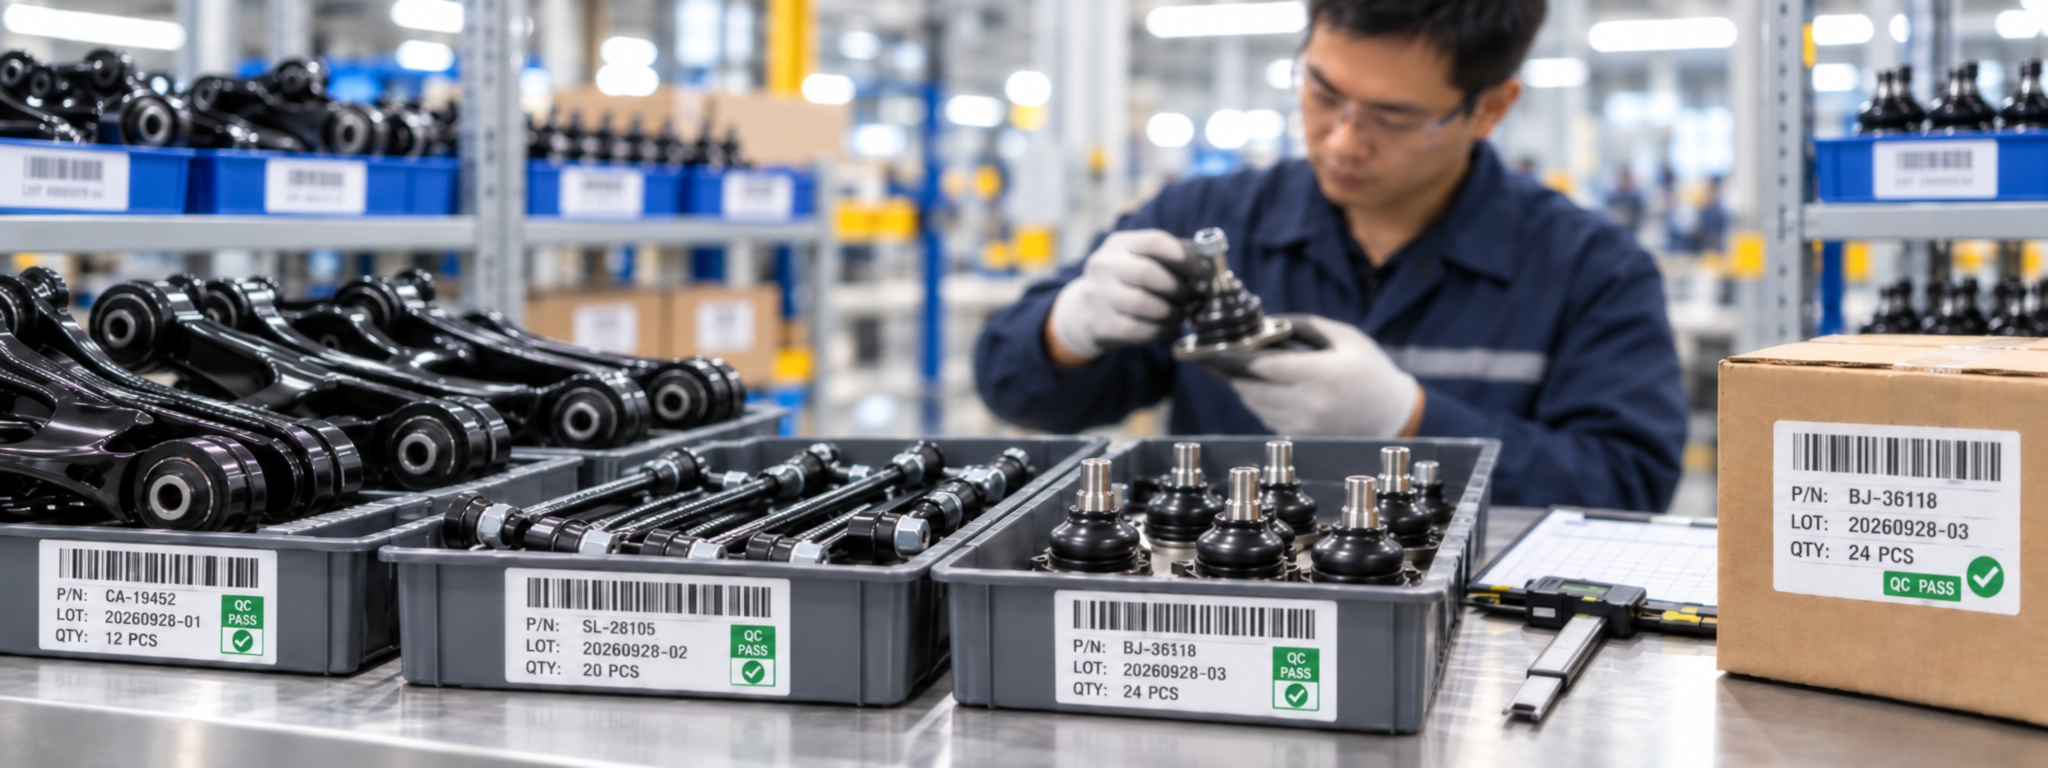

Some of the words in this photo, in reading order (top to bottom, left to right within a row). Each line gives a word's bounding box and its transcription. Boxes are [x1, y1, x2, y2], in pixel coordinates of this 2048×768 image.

[1791, 485, 1828, 503] P/N:
[1849, 488, 1938, 509] BJ-36118
[1791, 513, 1828, 531] LOT:
[1848, 516, 1969, 540] 20260928-03
[1790, 540, 1830, 559] QTY:
[1848, 544, 1871, 562] 24
[1878, 546, 1914, 565] PCS
[1889, 576, 1911, 593] QC
[1918, 578, 1955, 596] PASS
[57, 587, 87, 602] P/N:
[105, 589, 176, 606] CA-19452
[234, 599, 252, 612] QC
[56, 607, 88, 622] LOT:
[105, 610, 200, 628] 20260928-01
[228, 613, 257, 626] PASS
[526, 617, 559, 632] P/N:
[582, 619, 656, 636] SL-28105
[55, 628, 88, 643] QTY:
[106, 631, 123, 645] 12
[128, 632, 158, 648] PCS
[744, 629, 763, 643] QC
[526, 638, 560, 653] LOT:
[583, 641, 688, 659] 20260928-02
[738, 643, 768, 657] PASS
[1073, 639, 1105, 654] P/N:
[1286, 652, 1306, 666] QC
[525, 660, 561, 675] QTY:
[583, 663, 602, 677] 20
[608, 664, 640, 679] PCS
[1073, 660, 1107, 675] LOT:
[1123, 662, 1227, 681] 20260928-03
[1280, 666, 1312, 680] PASS
[1073, 681, 1107, 696] QTY:
[1123, 684, 1142, 699] 24
[1148, 685, 1179, 701] PCS
